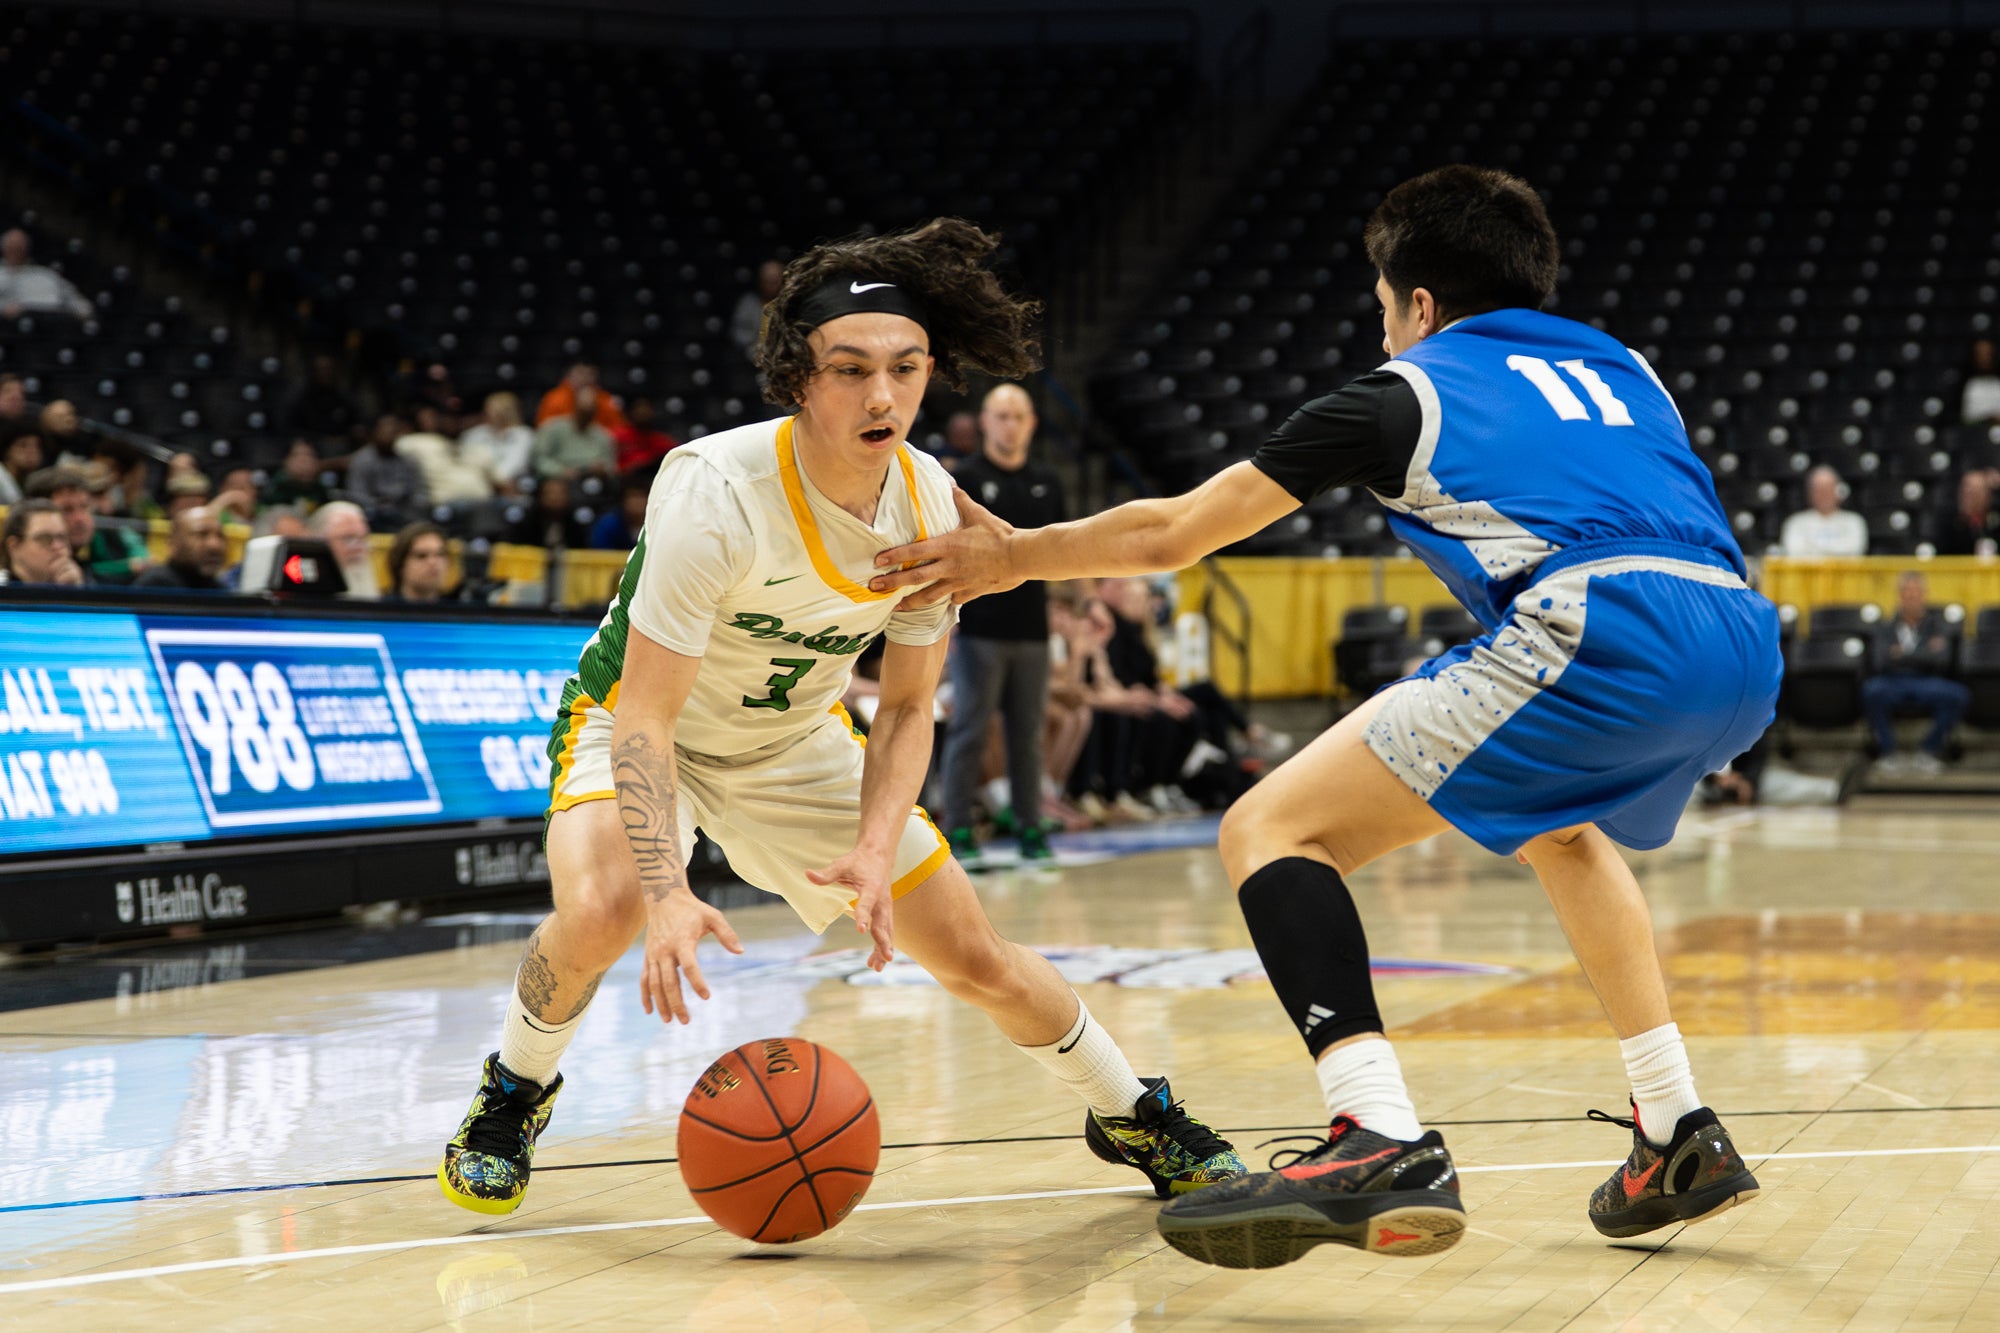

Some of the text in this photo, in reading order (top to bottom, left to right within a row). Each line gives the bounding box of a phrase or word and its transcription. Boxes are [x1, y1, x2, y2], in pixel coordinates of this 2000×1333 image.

[1506, 354, 1635, 426] 11
[0, 667, 84, 741] ALL,
[742, 658, 817, 711] 3
[175, 661, 315, 795] 988
[138, 872, 248, 925] Health Care
[705, 1062, 742, 1093] ACY
[764, 1039, 801, 1075] ING
